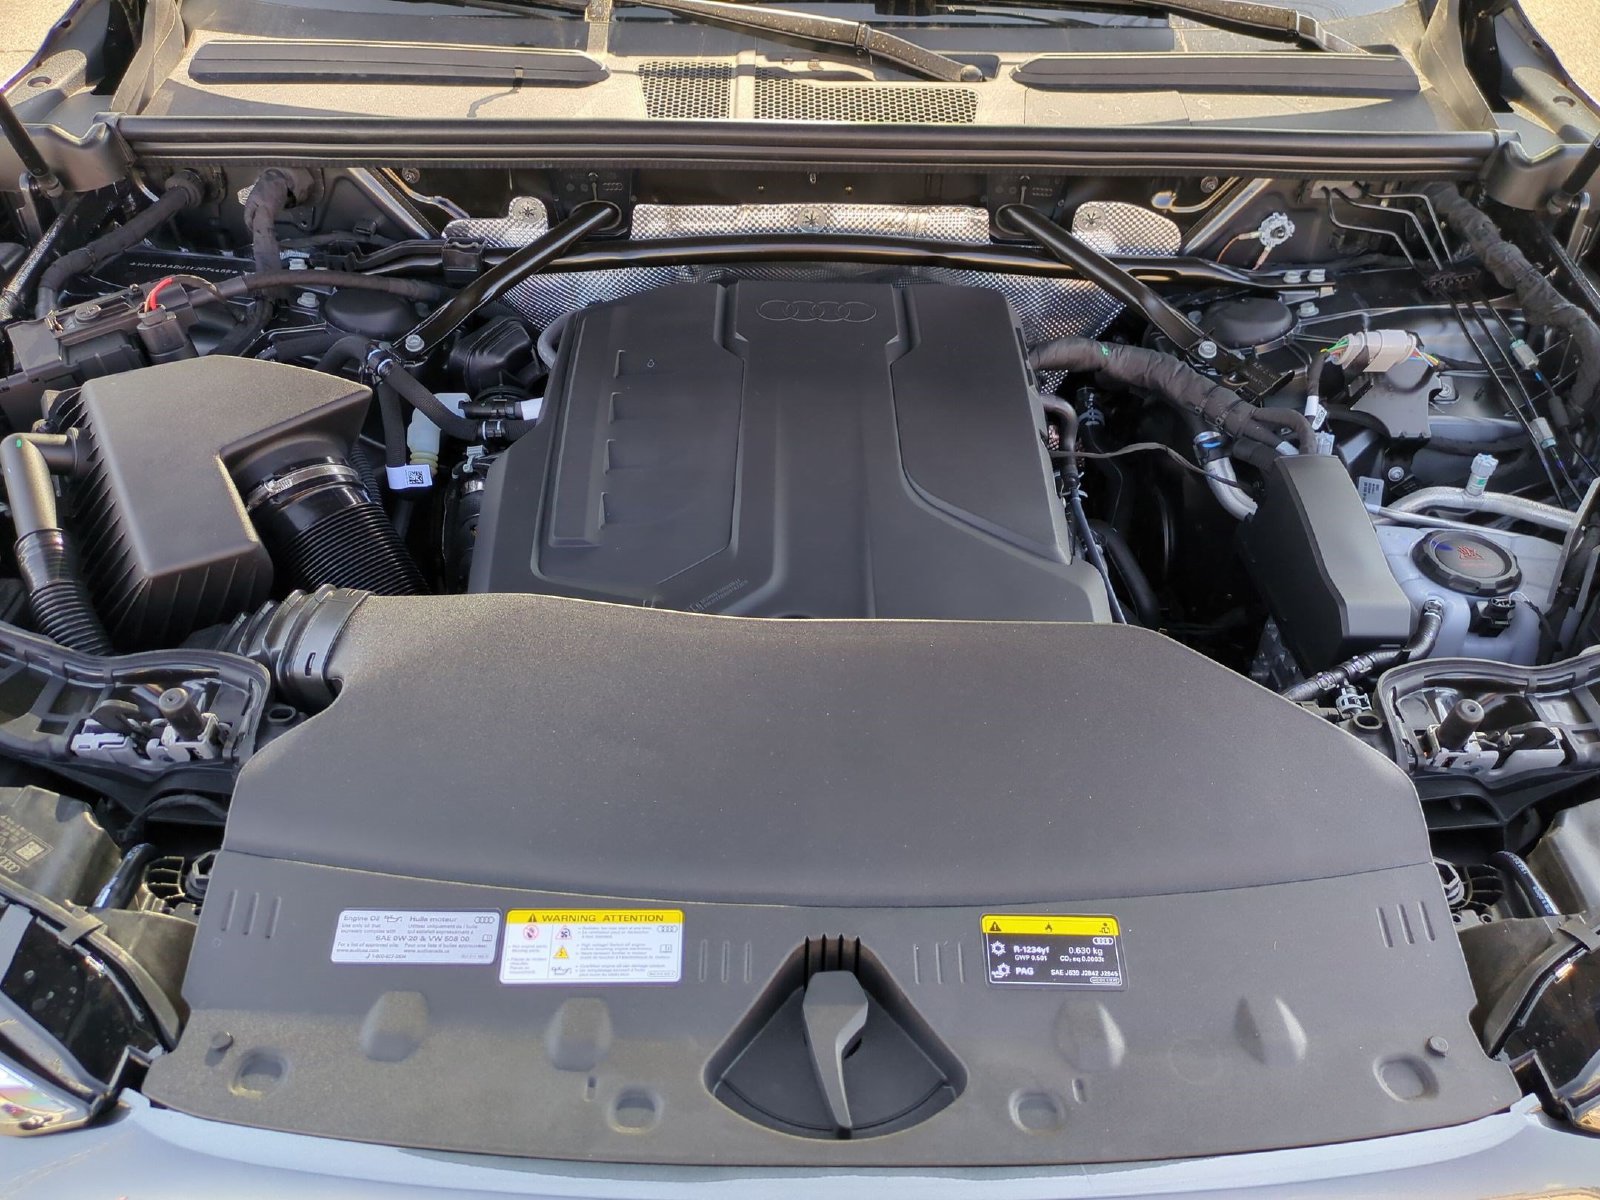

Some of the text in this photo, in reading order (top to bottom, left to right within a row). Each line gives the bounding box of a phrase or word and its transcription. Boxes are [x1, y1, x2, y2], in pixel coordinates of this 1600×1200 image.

[541, 914, 664, 922] WARNING ATTENTION
[1013, 945, 1050, 955] R-1234yf
[1092, 947, 1103, 956] kg
[1015, 967, 1034, 975] PAG
